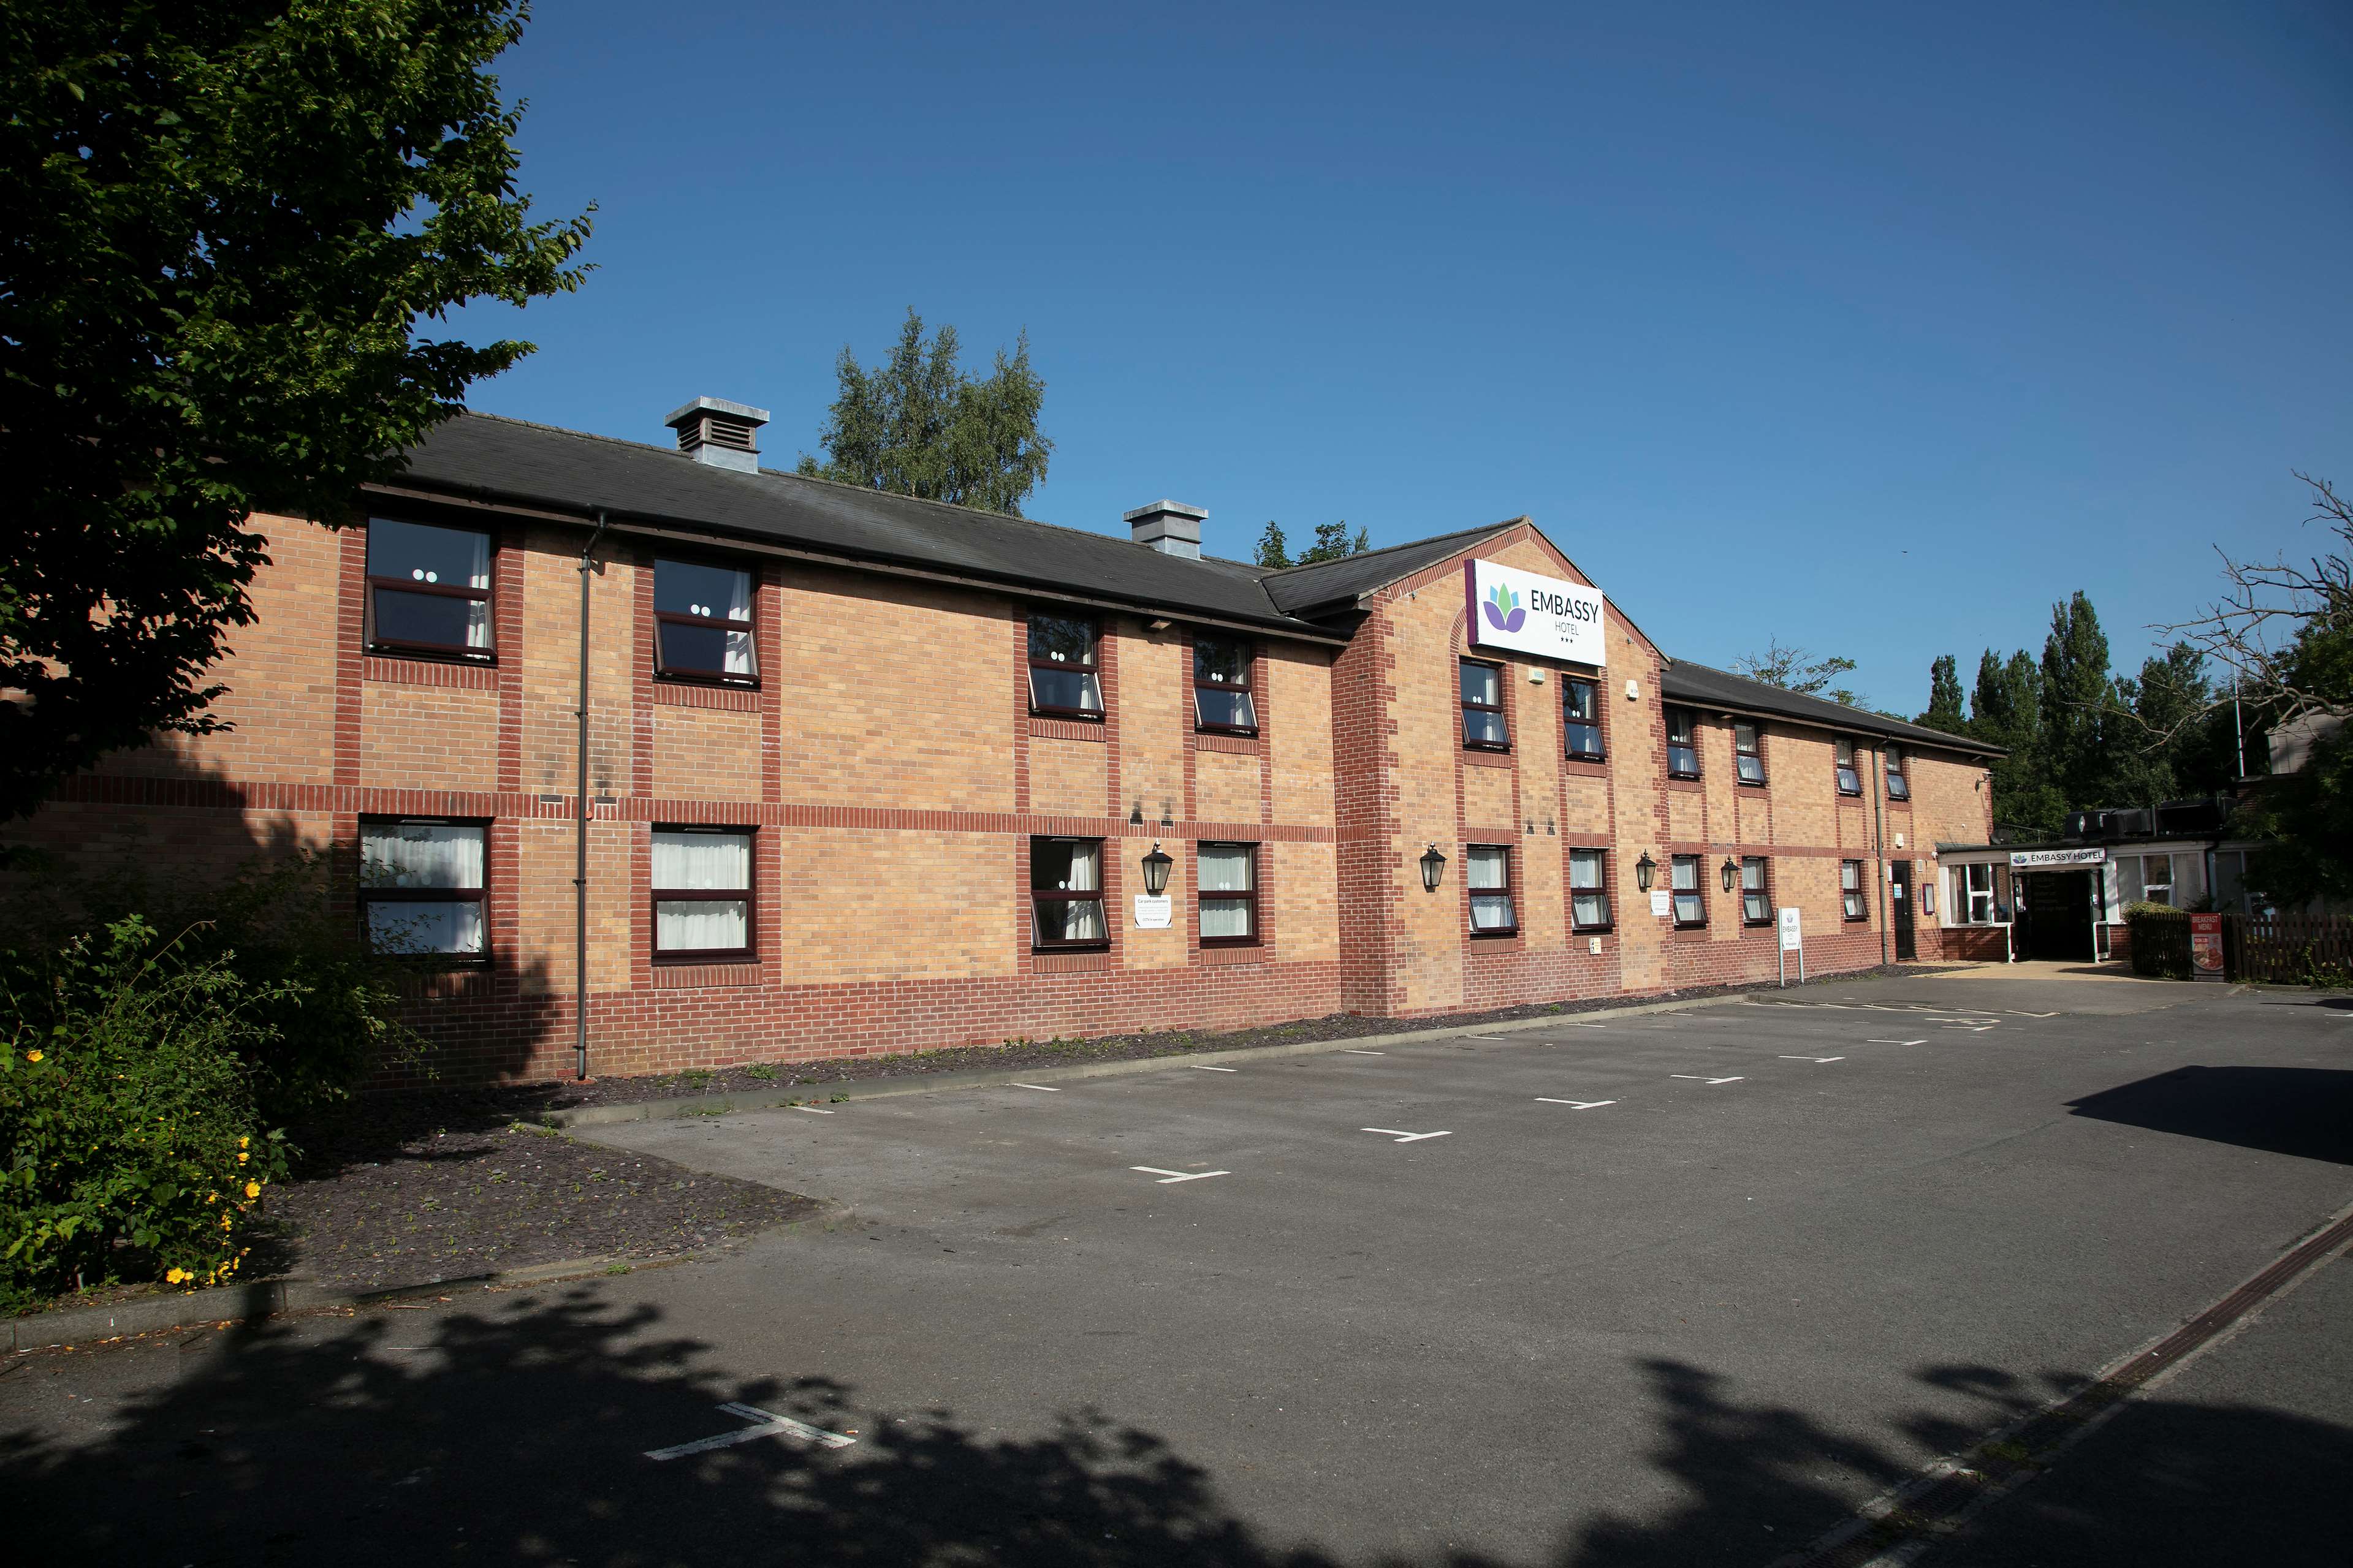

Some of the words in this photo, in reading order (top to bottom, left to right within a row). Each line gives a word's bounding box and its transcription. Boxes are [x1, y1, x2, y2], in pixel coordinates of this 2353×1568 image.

[1531, 589, 1598, 623] EMBASSY
[1555, 621, 1579, 636] HOTEL
[2031, 853, 2073, 862] EMBASSY
[2074, 852, 2103, 860] HOTEL
